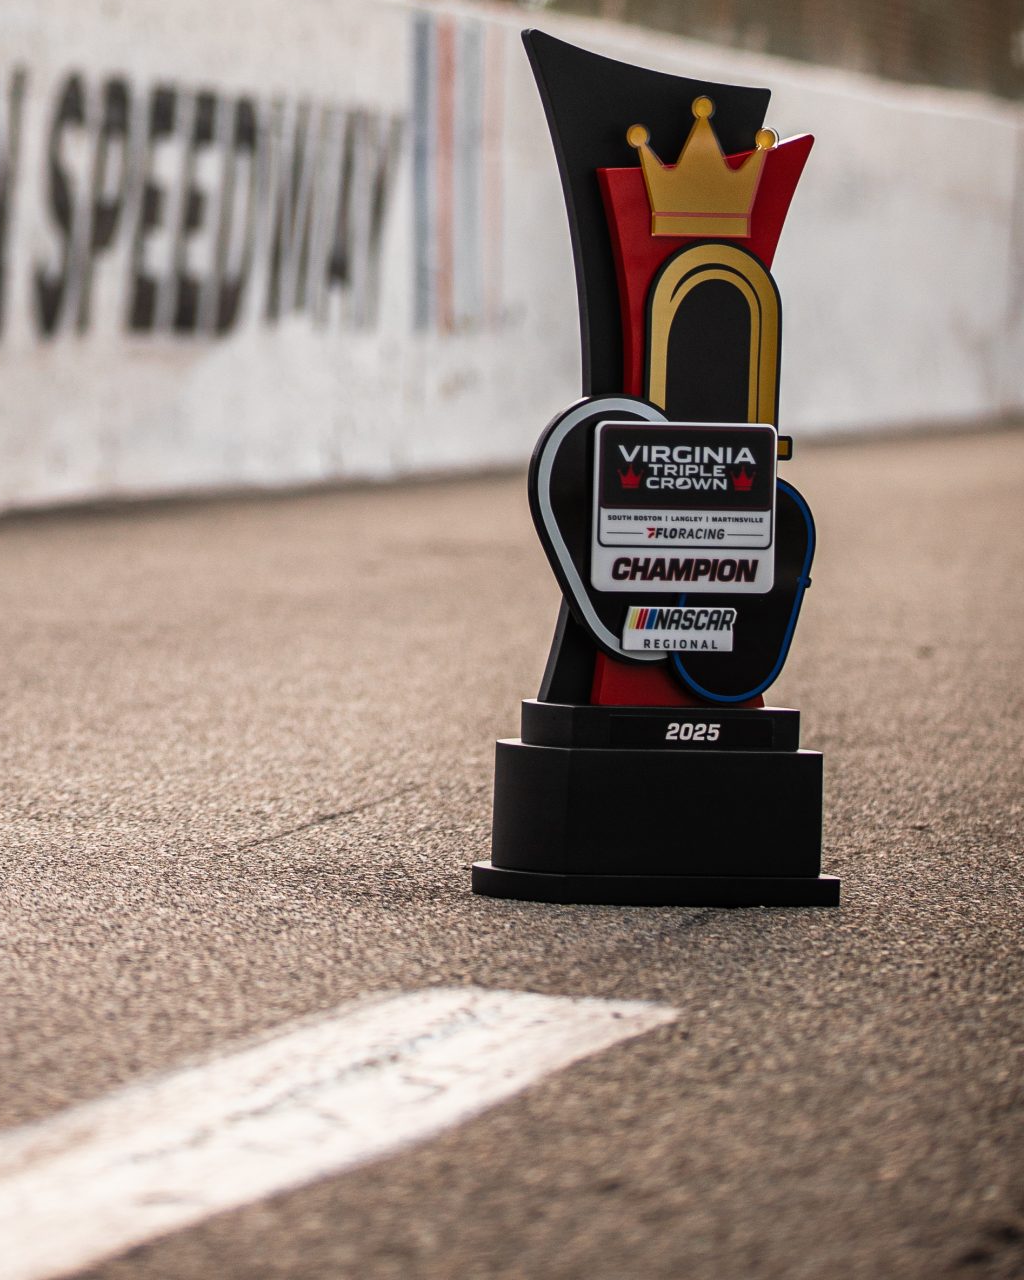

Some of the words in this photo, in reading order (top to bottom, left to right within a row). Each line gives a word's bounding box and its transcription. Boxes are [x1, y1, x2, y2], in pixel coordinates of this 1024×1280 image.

[34, 70, 406, 341] SPEEDWAY
[618, 444, 756, 465] VIRGINIA
[648, 463, 726, 477] TRIPLE
[645, 477, 728, 491] CROWN
[711, 516, 764, 524] MARTINSVILLE
[655, 527, 725, 540] FLORACING
[611, 557, 759, 583] CHAMPION
[654, 608, 736, 631] NASCAR
[643, 638, 718, 650] REGIONAL
[665, 722, 721, 741] 2025
